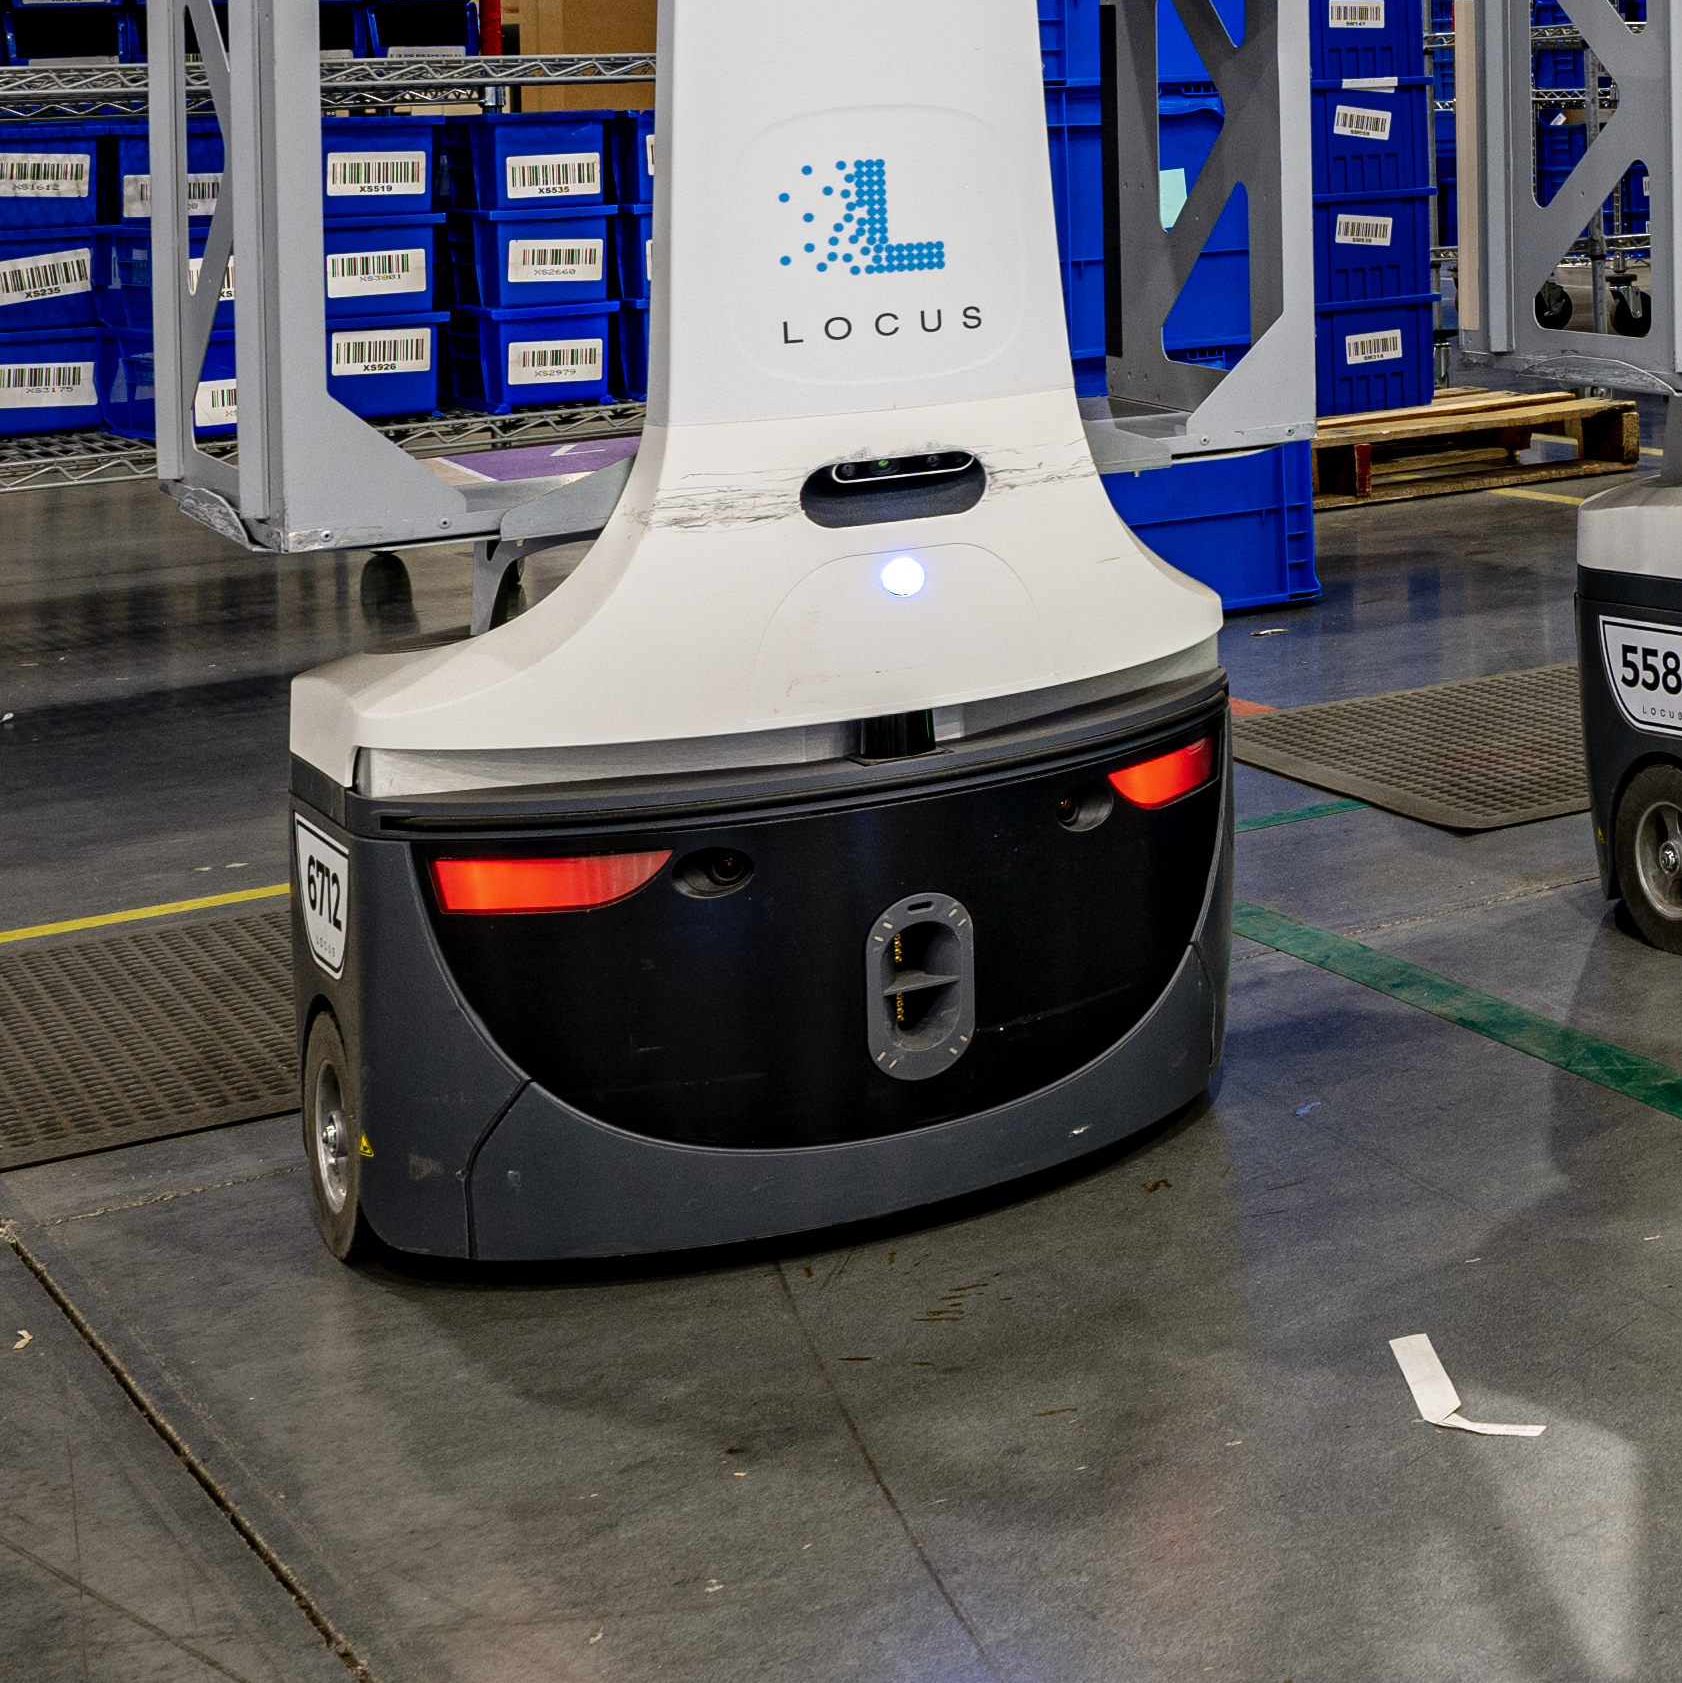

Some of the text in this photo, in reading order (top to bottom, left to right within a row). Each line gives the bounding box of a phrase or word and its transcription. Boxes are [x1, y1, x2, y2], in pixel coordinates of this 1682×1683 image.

[13, 183, 60, 191] XS1612
[359, 185, 393, 193] XS519
[538, 186, 570, 195] XS535
[534, 268, 576, 276] XS2660
[25, 287, 61, 299] XS235
[782, 305, 983, 344] LOCUS
[363, 363, 396, 372] XS926
[534, 369, 576, 378] XS2979
[26, 386, 74, 394] XS3175
[307, 854, 342, 932] 6712
